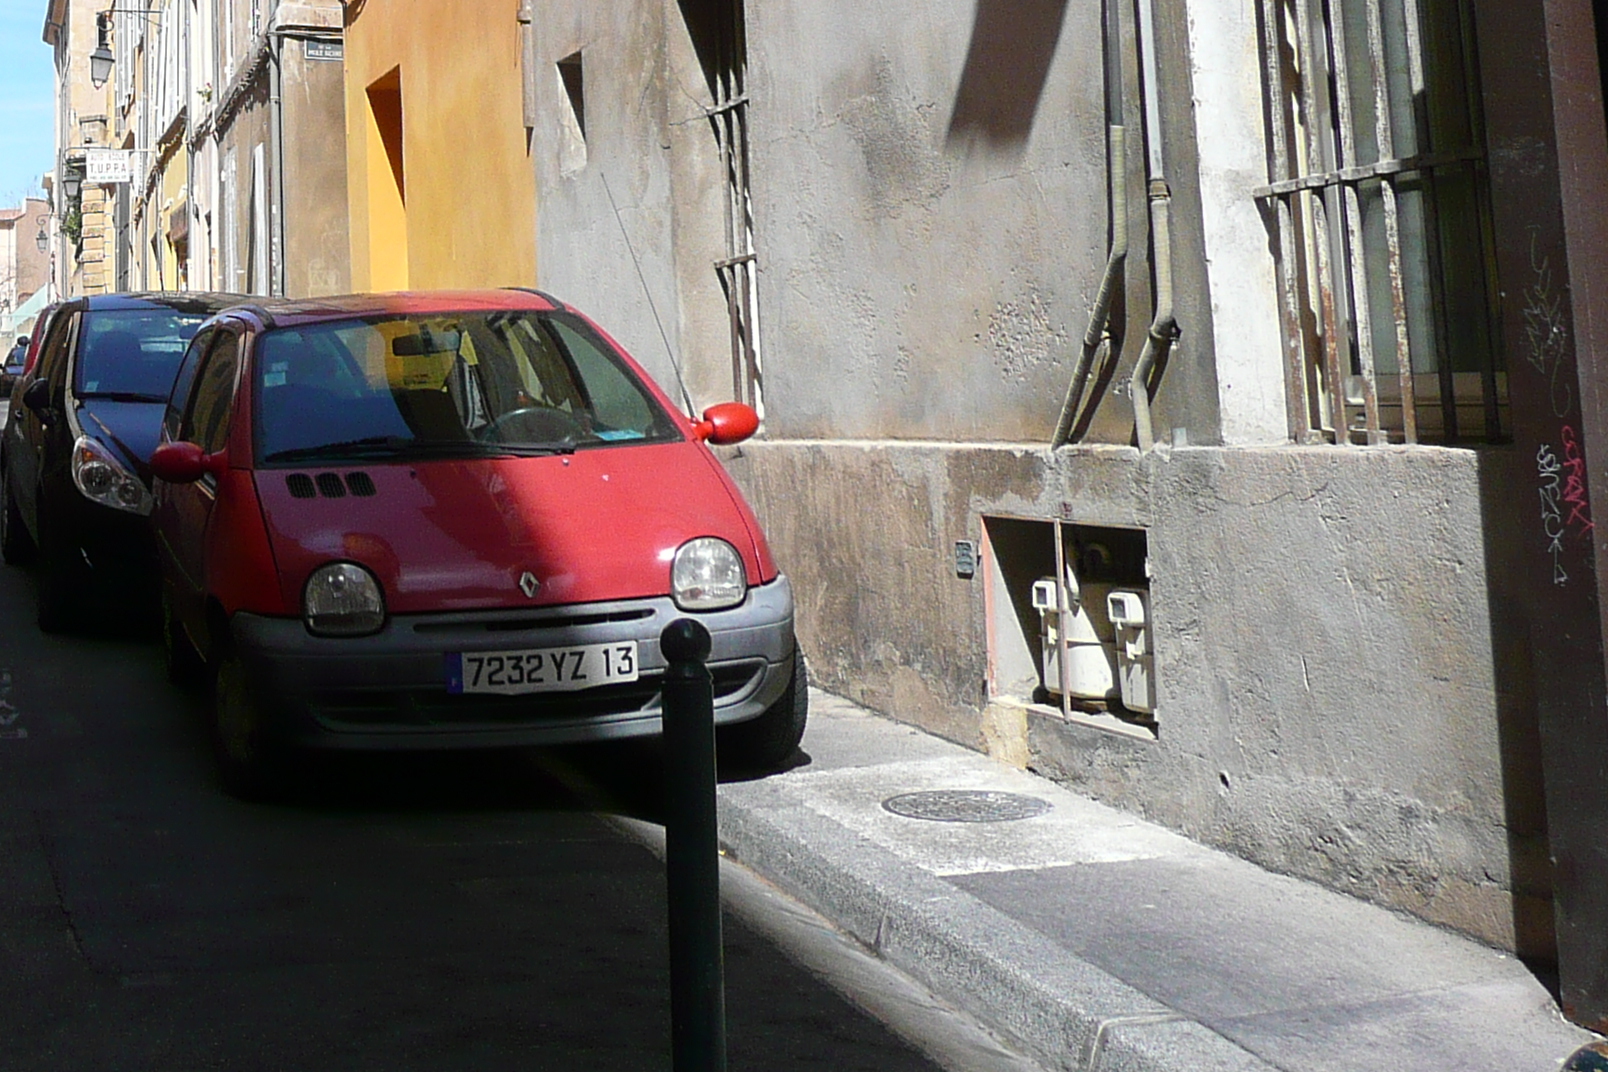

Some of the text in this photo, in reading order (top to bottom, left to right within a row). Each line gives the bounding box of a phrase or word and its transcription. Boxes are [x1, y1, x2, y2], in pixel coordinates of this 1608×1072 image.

[467, 646, 633, 687] 7232 YZ 13
